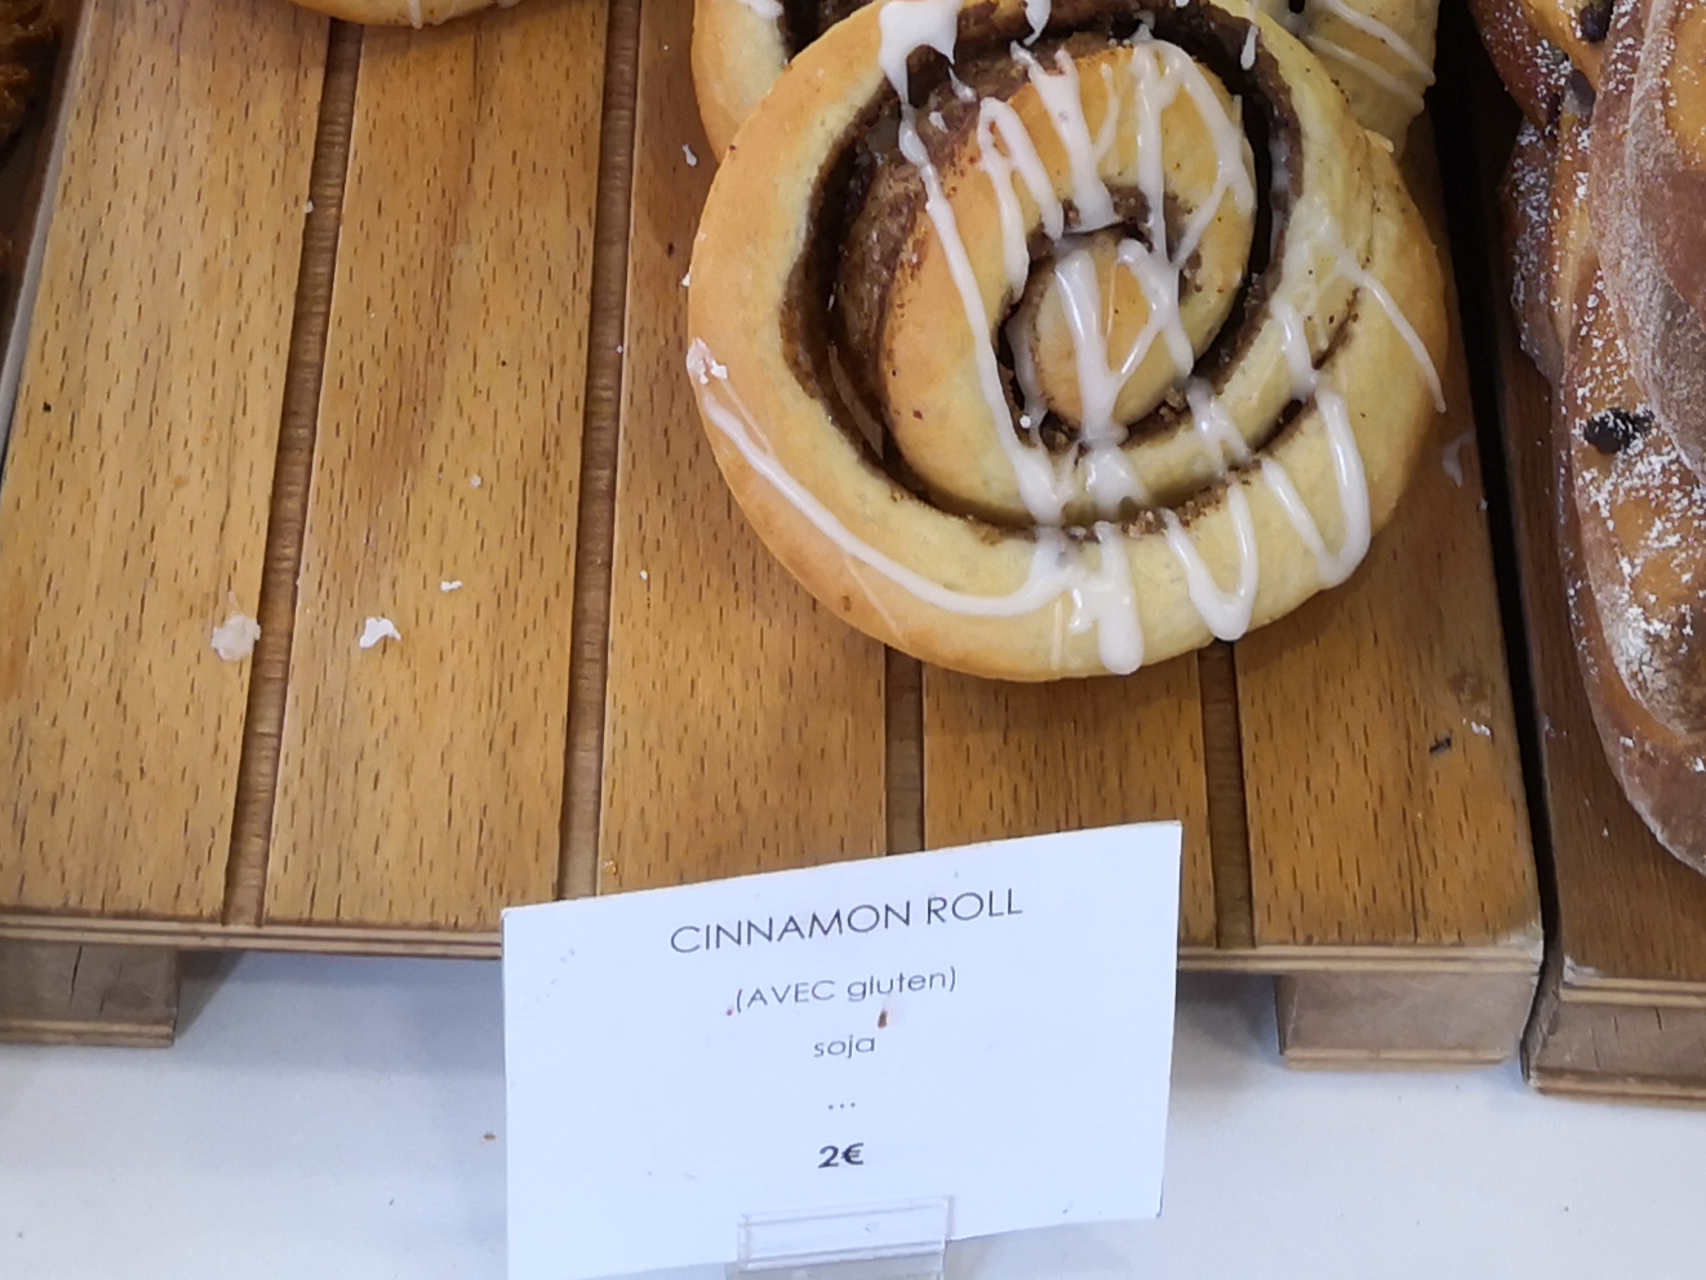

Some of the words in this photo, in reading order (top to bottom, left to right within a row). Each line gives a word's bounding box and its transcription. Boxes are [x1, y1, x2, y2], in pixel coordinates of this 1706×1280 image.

[670, 900, 913, 955] CINNAMON
[926, 887, 1024, 924] ROLL
[735, 977, 836, 1015] (AVEC
[846, 965, 958, 1000] gluten)
[813, 1032, 876, 1059] soja
[817, 1142, 865, 1168] 2€
